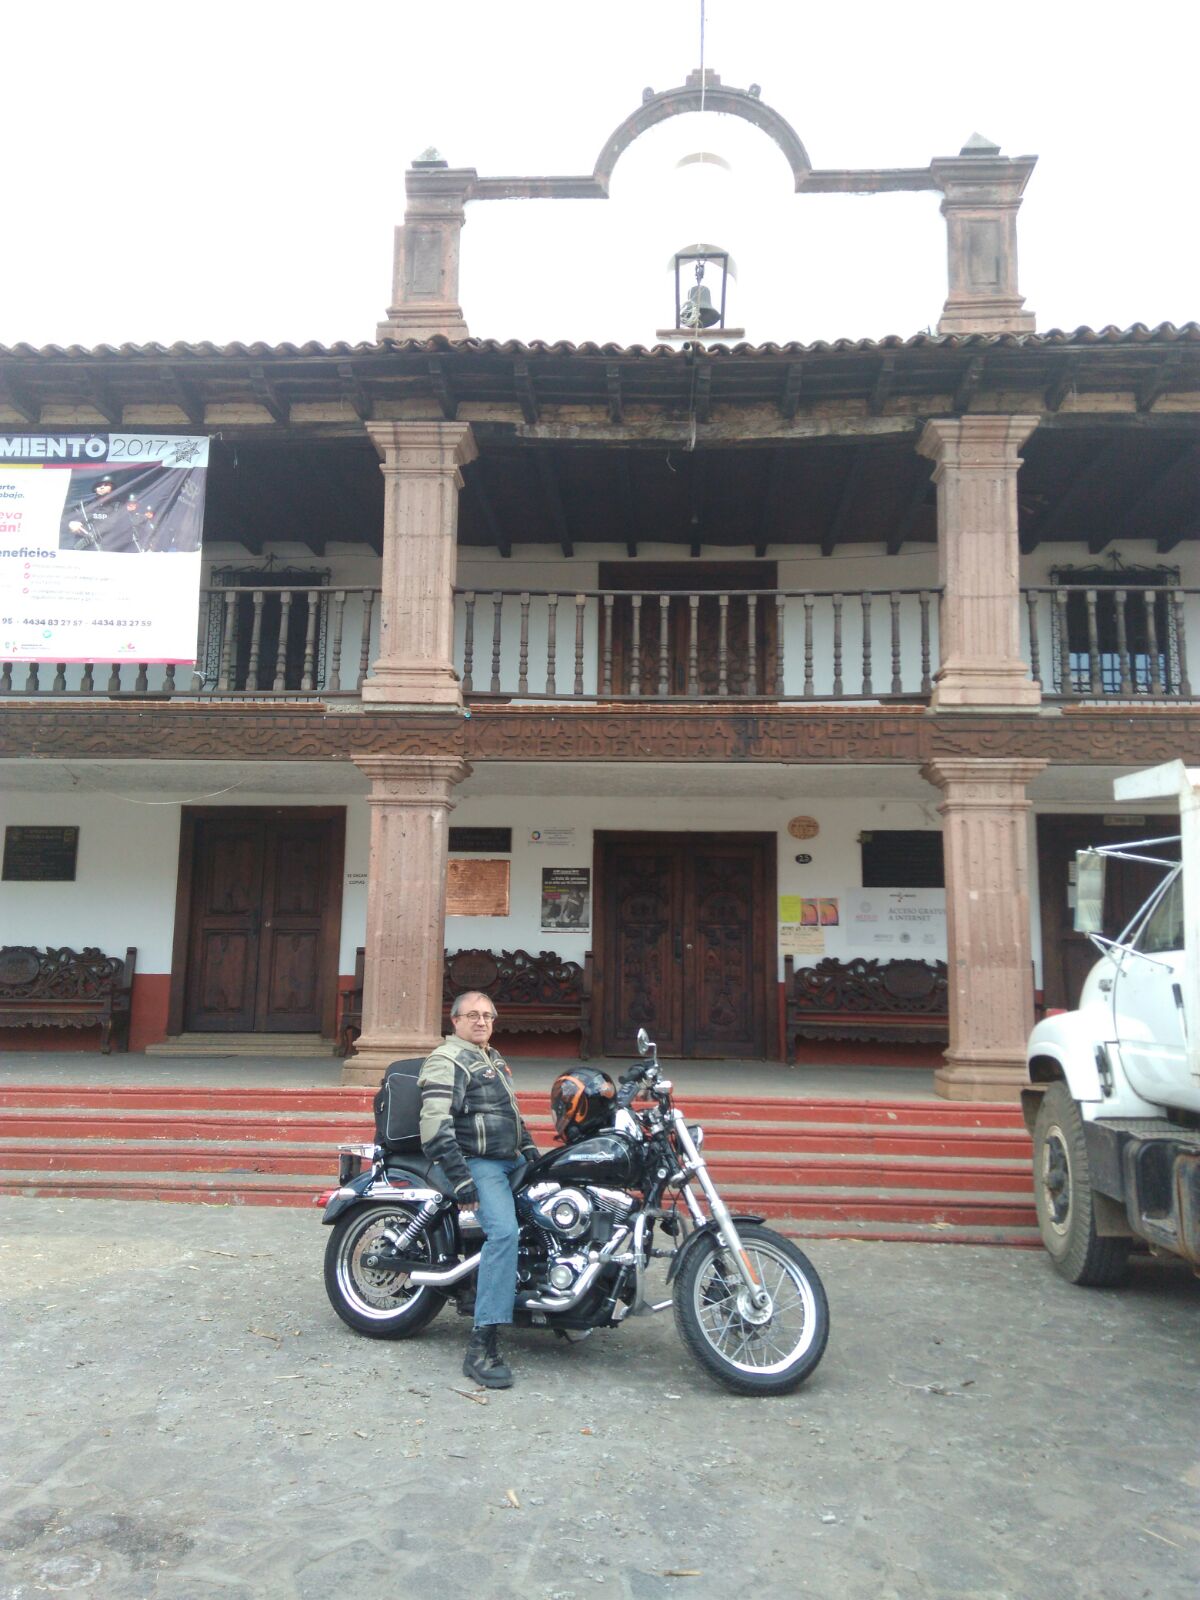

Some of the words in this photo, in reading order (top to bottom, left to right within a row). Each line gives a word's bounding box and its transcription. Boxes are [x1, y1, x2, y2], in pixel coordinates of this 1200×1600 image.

[111, 438, 169, 457] 2017
[22, 618, 46, 626] 4434
[497, 737, 712, 757] PRESIDENCIA
[724, 738, 906, 758] MUNICIPAL
[888, 907, 918, 915] ACCESO
